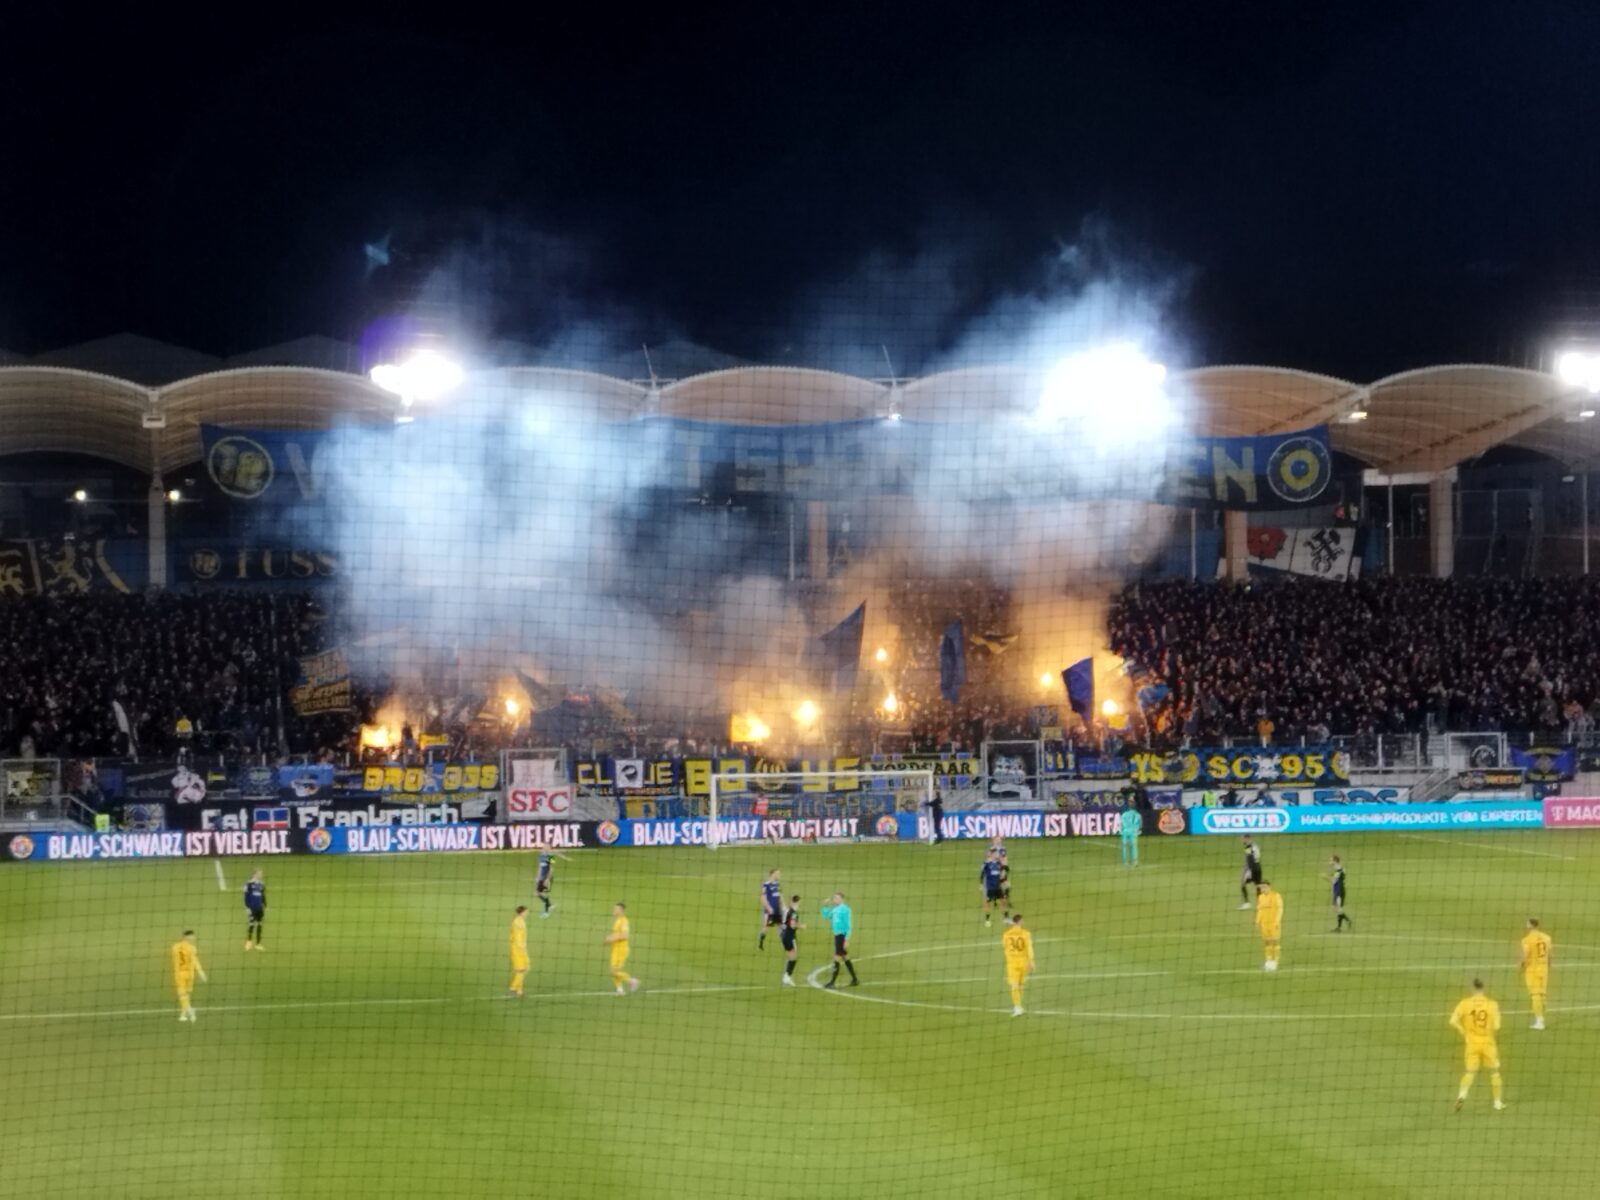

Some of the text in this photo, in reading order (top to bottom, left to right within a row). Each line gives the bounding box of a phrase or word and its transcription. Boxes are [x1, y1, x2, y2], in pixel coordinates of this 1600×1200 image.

[1281, 755, 1324, 779] 95
[508, 789, 571, 813] SFC
[296, 802, 458, 829] Frankreich
[1045, 813, 1069, 836] IST
[1070, 812, 1122, 836] VIELFA
[1212, 814, 1281, 829] wavin
[347, 826, 478, 852] BLAU-SCHWARZ
[481, 825, 508, 850] IST
[762, 819, 786, 838] IST
[48, 830, 291, 859] BLAU-SCHWARZ IST VIELFALT.
[1008, 935, 1026, 953] 30
[1469, 1008, 1488, 1029] 19
